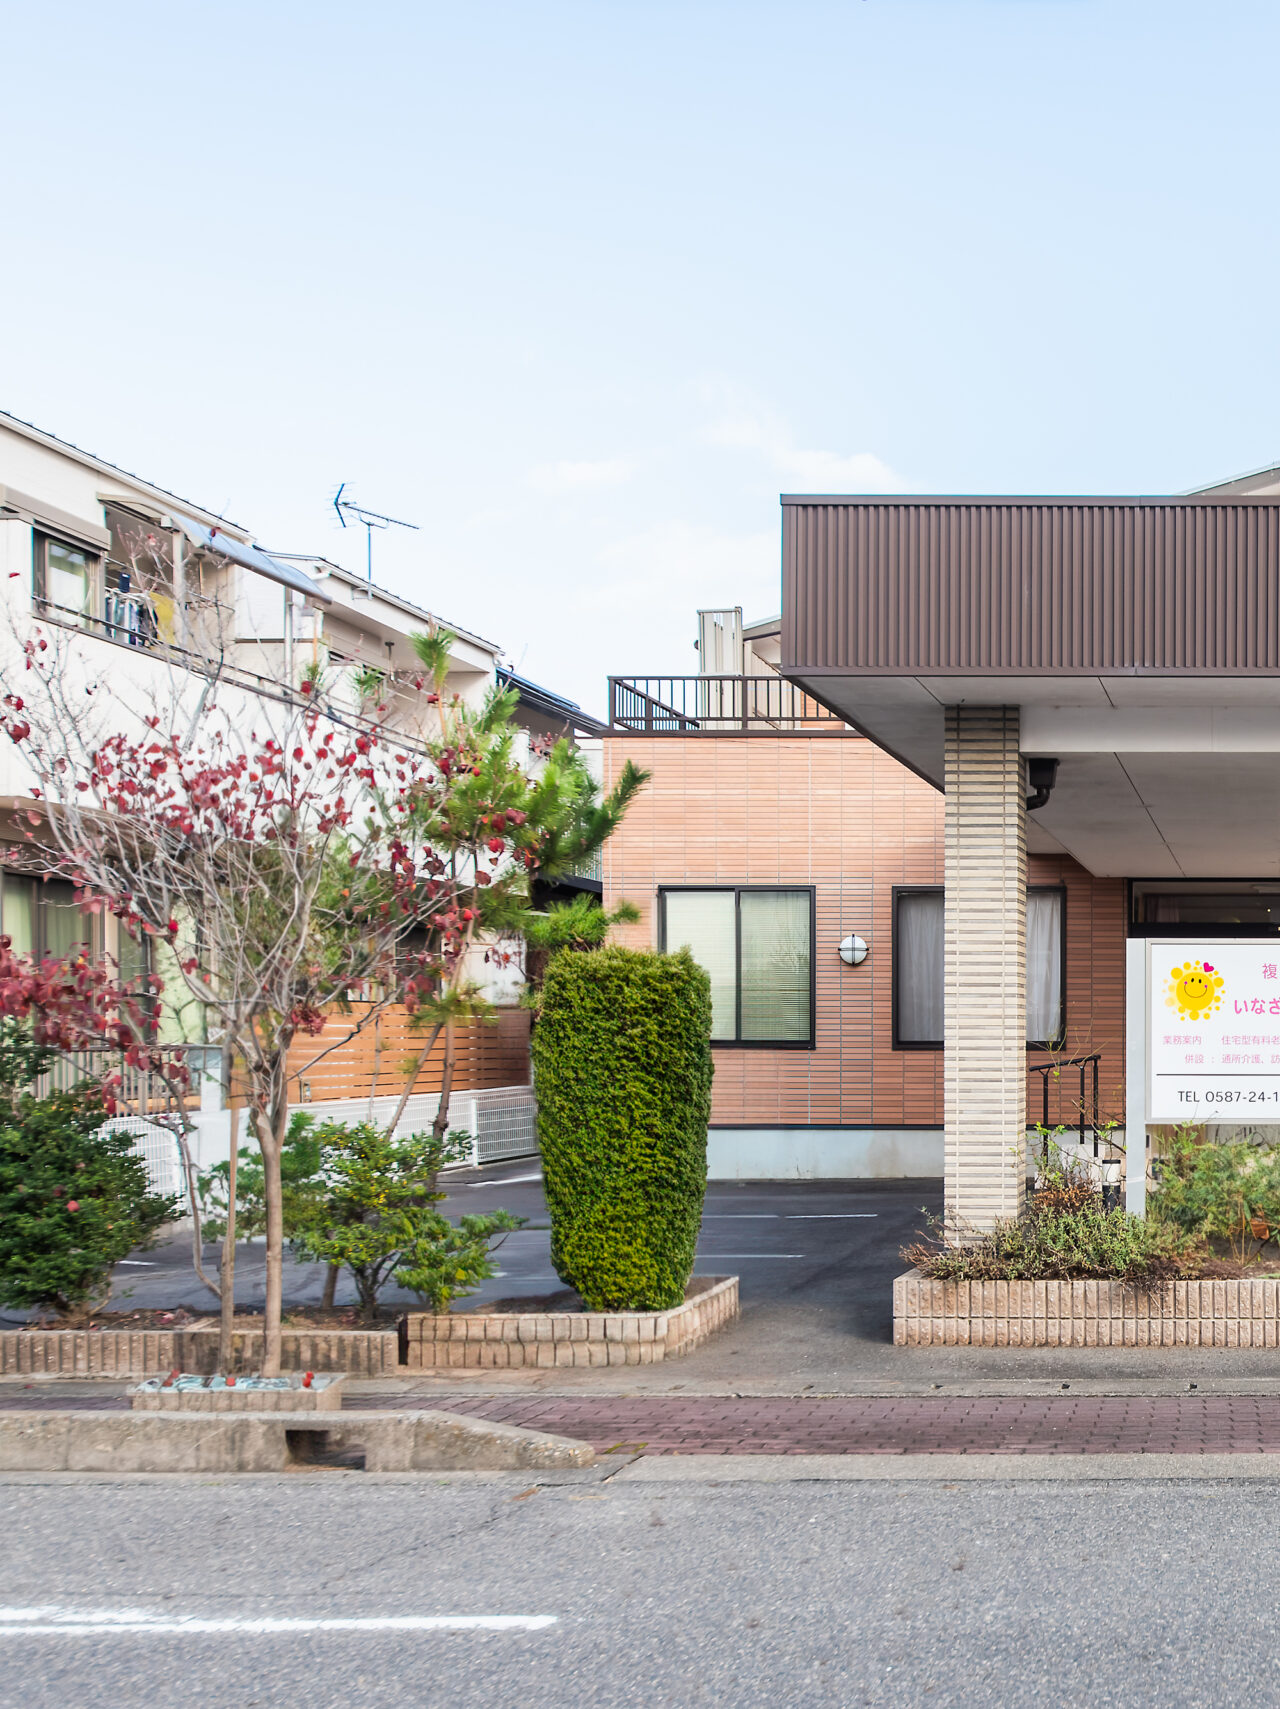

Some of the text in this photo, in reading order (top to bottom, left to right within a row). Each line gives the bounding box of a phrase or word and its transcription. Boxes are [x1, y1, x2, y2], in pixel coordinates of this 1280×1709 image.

[1163, 1035, 1202, 1045] 業務案内
[1178, 1091, 1200, 1103] TEL
